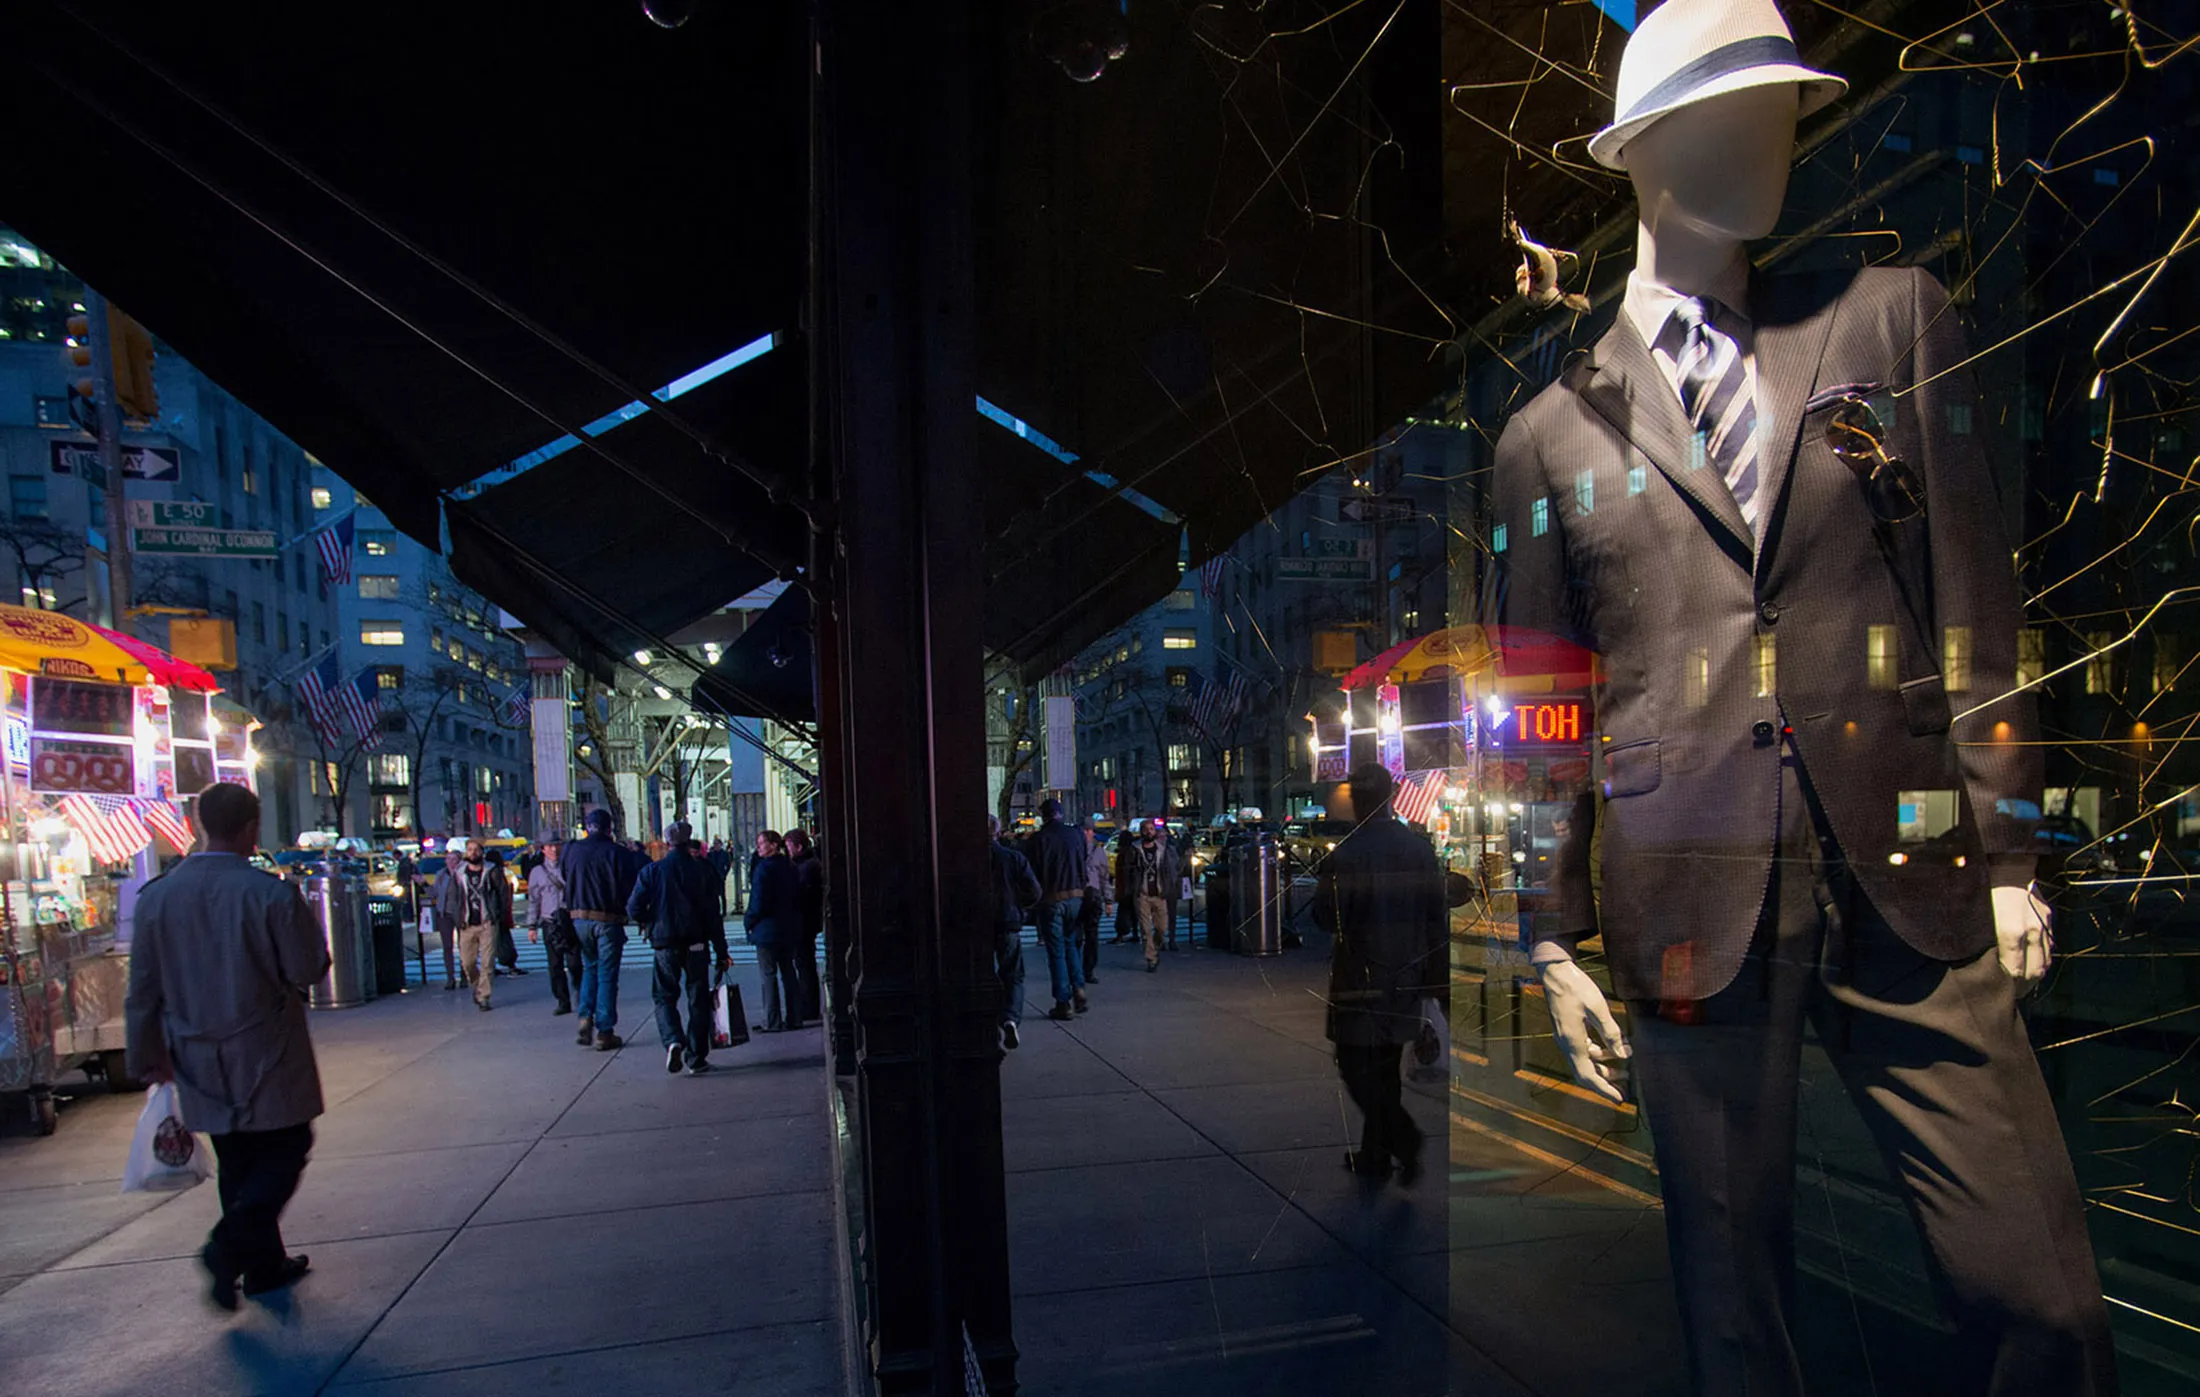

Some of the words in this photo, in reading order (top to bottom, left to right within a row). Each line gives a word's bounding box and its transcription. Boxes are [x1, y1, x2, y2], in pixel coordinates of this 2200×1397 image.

[163, 504, 174, 518] E
[182, 505, 206, 520] 50
[171, 531, 223, 547] CARDINAL
